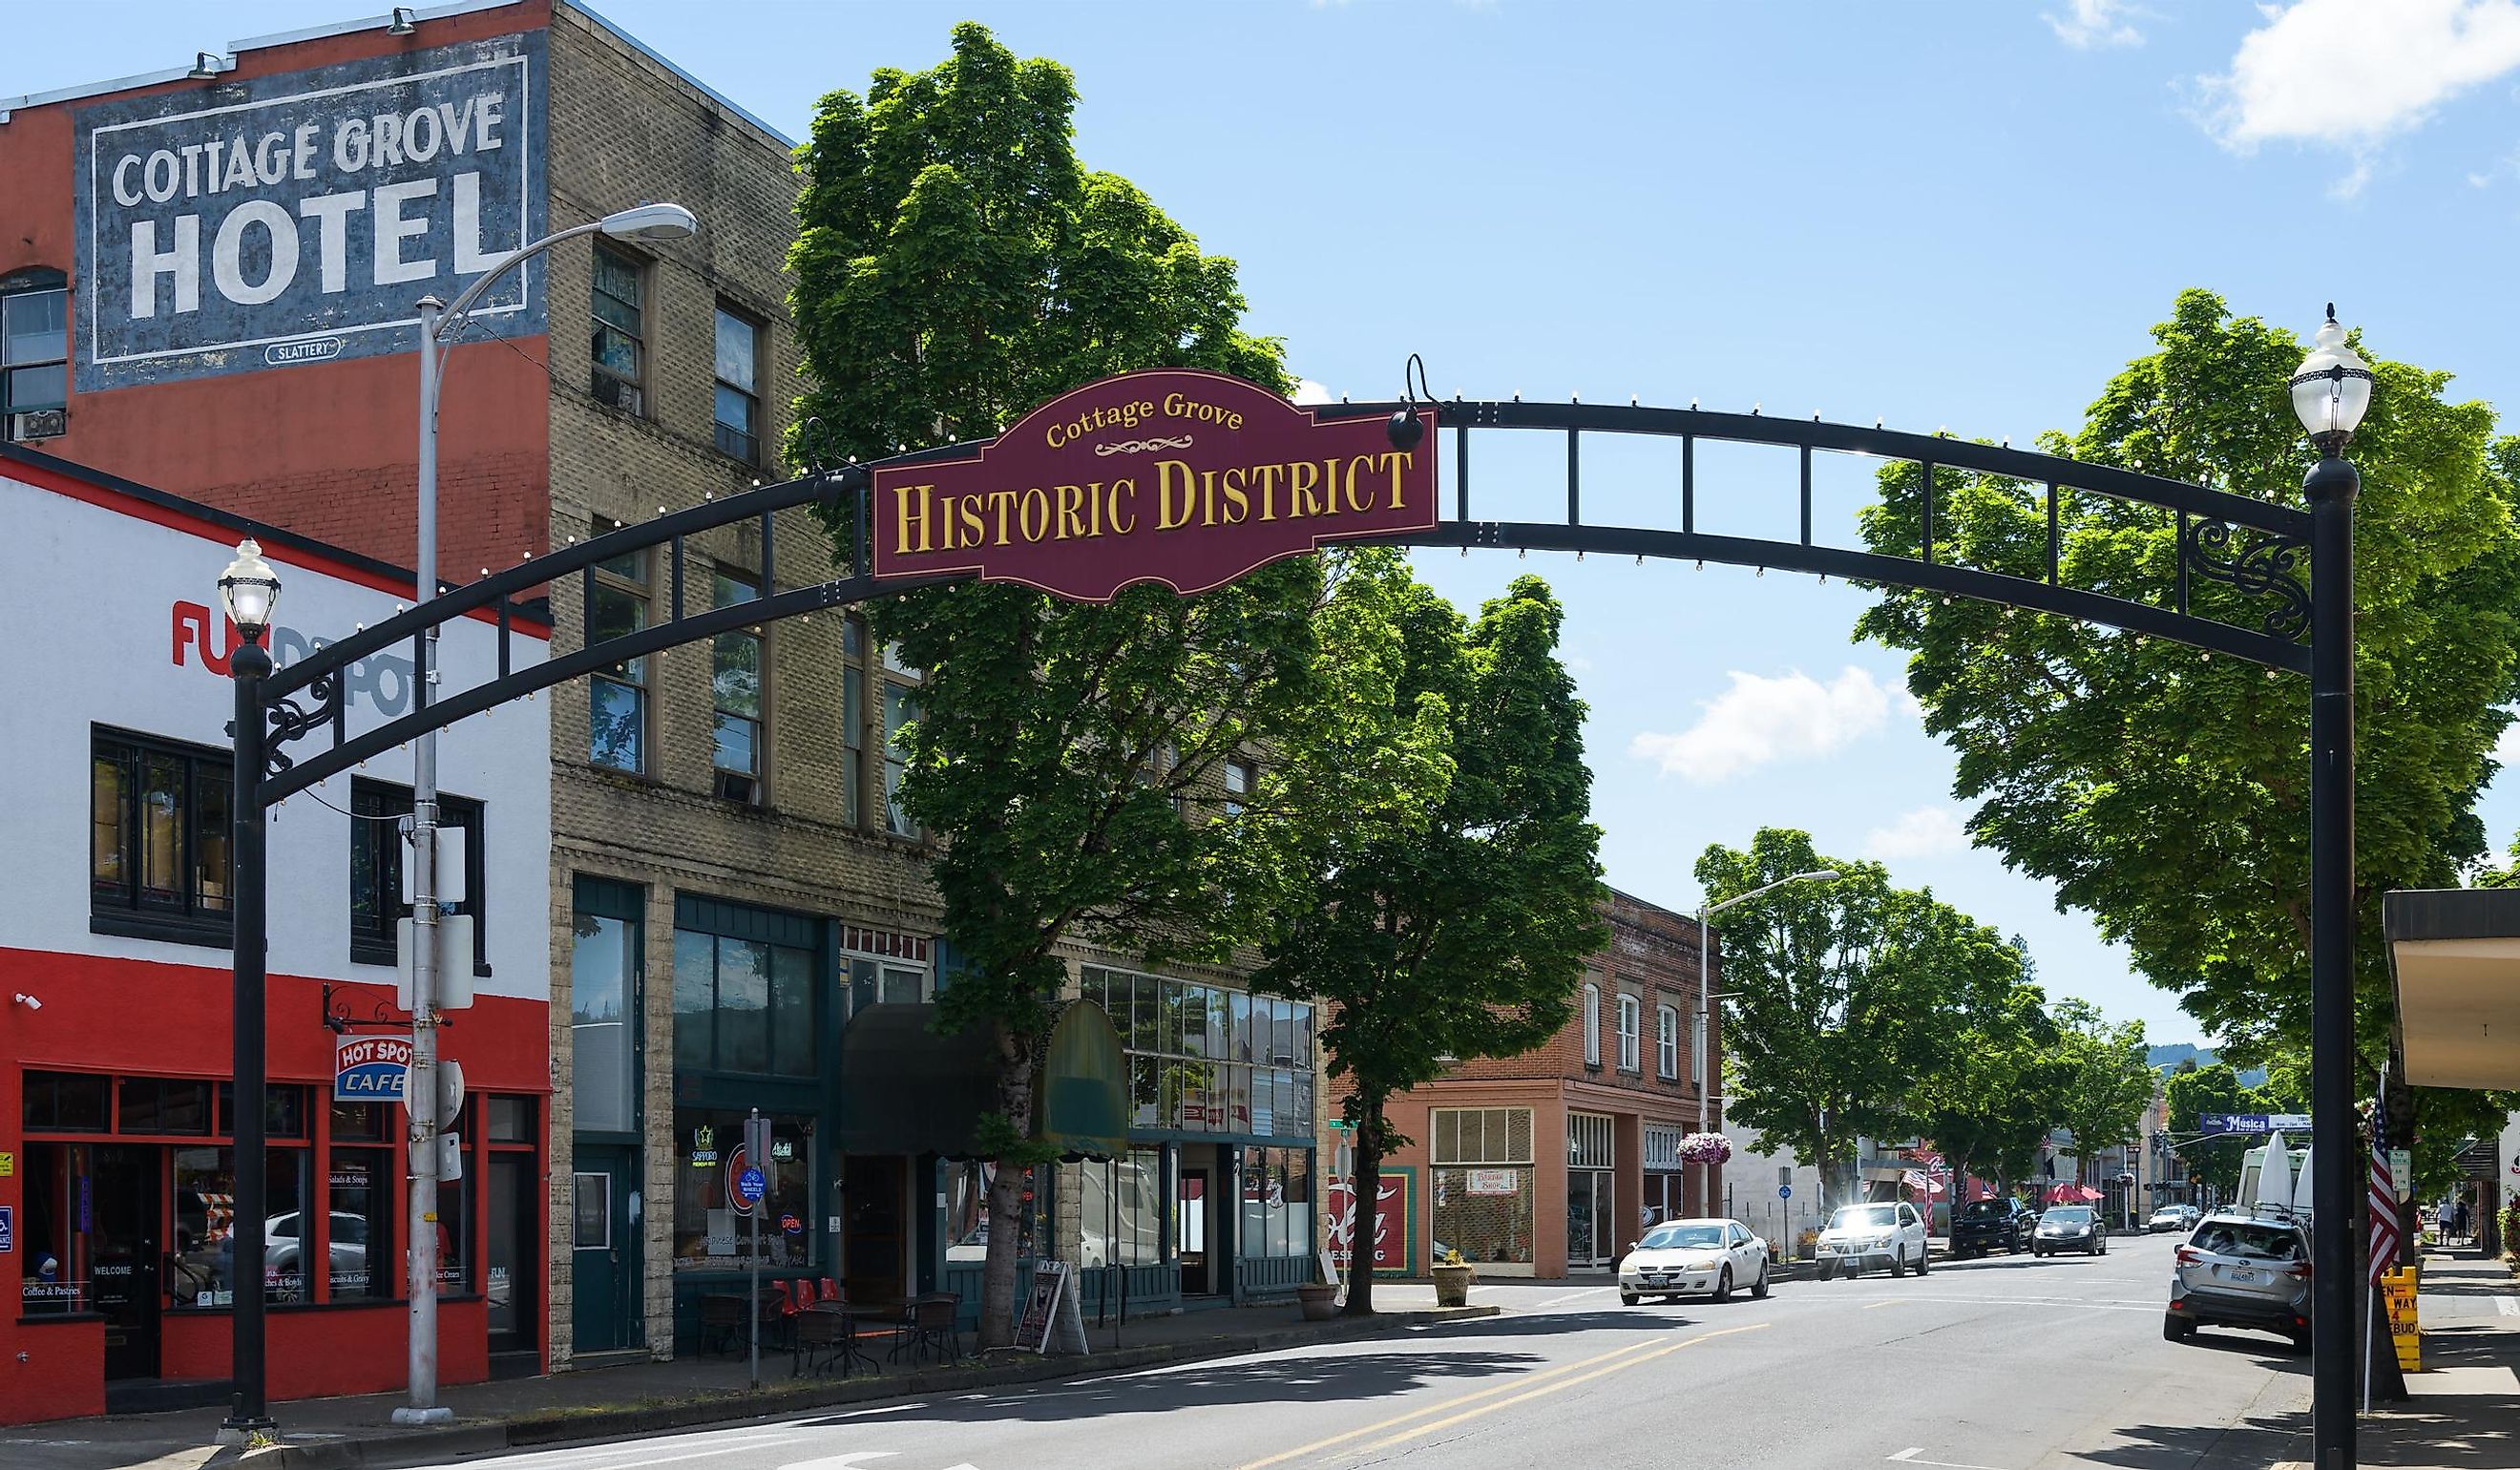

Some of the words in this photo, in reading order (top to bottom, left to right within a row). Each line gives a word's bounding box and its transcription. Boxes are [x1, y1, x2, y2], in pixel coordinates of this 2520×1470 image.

[113, 124, 320, 207] COTTAGE
[334, 94, 503, 173] GROVE
[131, 171, 521, 320] HOTEL
[277, 341, 330, 362] SLATTERY
[1046, 399, 1155, 449] Cottage
[1164, 391, 1245, 430] Grove
[893, 478, 1137, 554] HISTORIC
[1155, 452, 1413, 531] DISTRICT
[343, 1041, 374, 1066] HOT
[346, 1074, 405, 1091] CAFE
[692, 1151, 717, 1161] SAPPORO
[346, 1175, 351, 1184] &
[781, 1218, 802, 1229] OPEN
[94, 1266, 132, 1275] WELCOME
[23, 1287, 45, 1296] Coffee
[47, 1287, 53, 1296] &
[55, 1286, 81, 1296] Pastries
[2394, 1298, 2416, 1309] WAY
